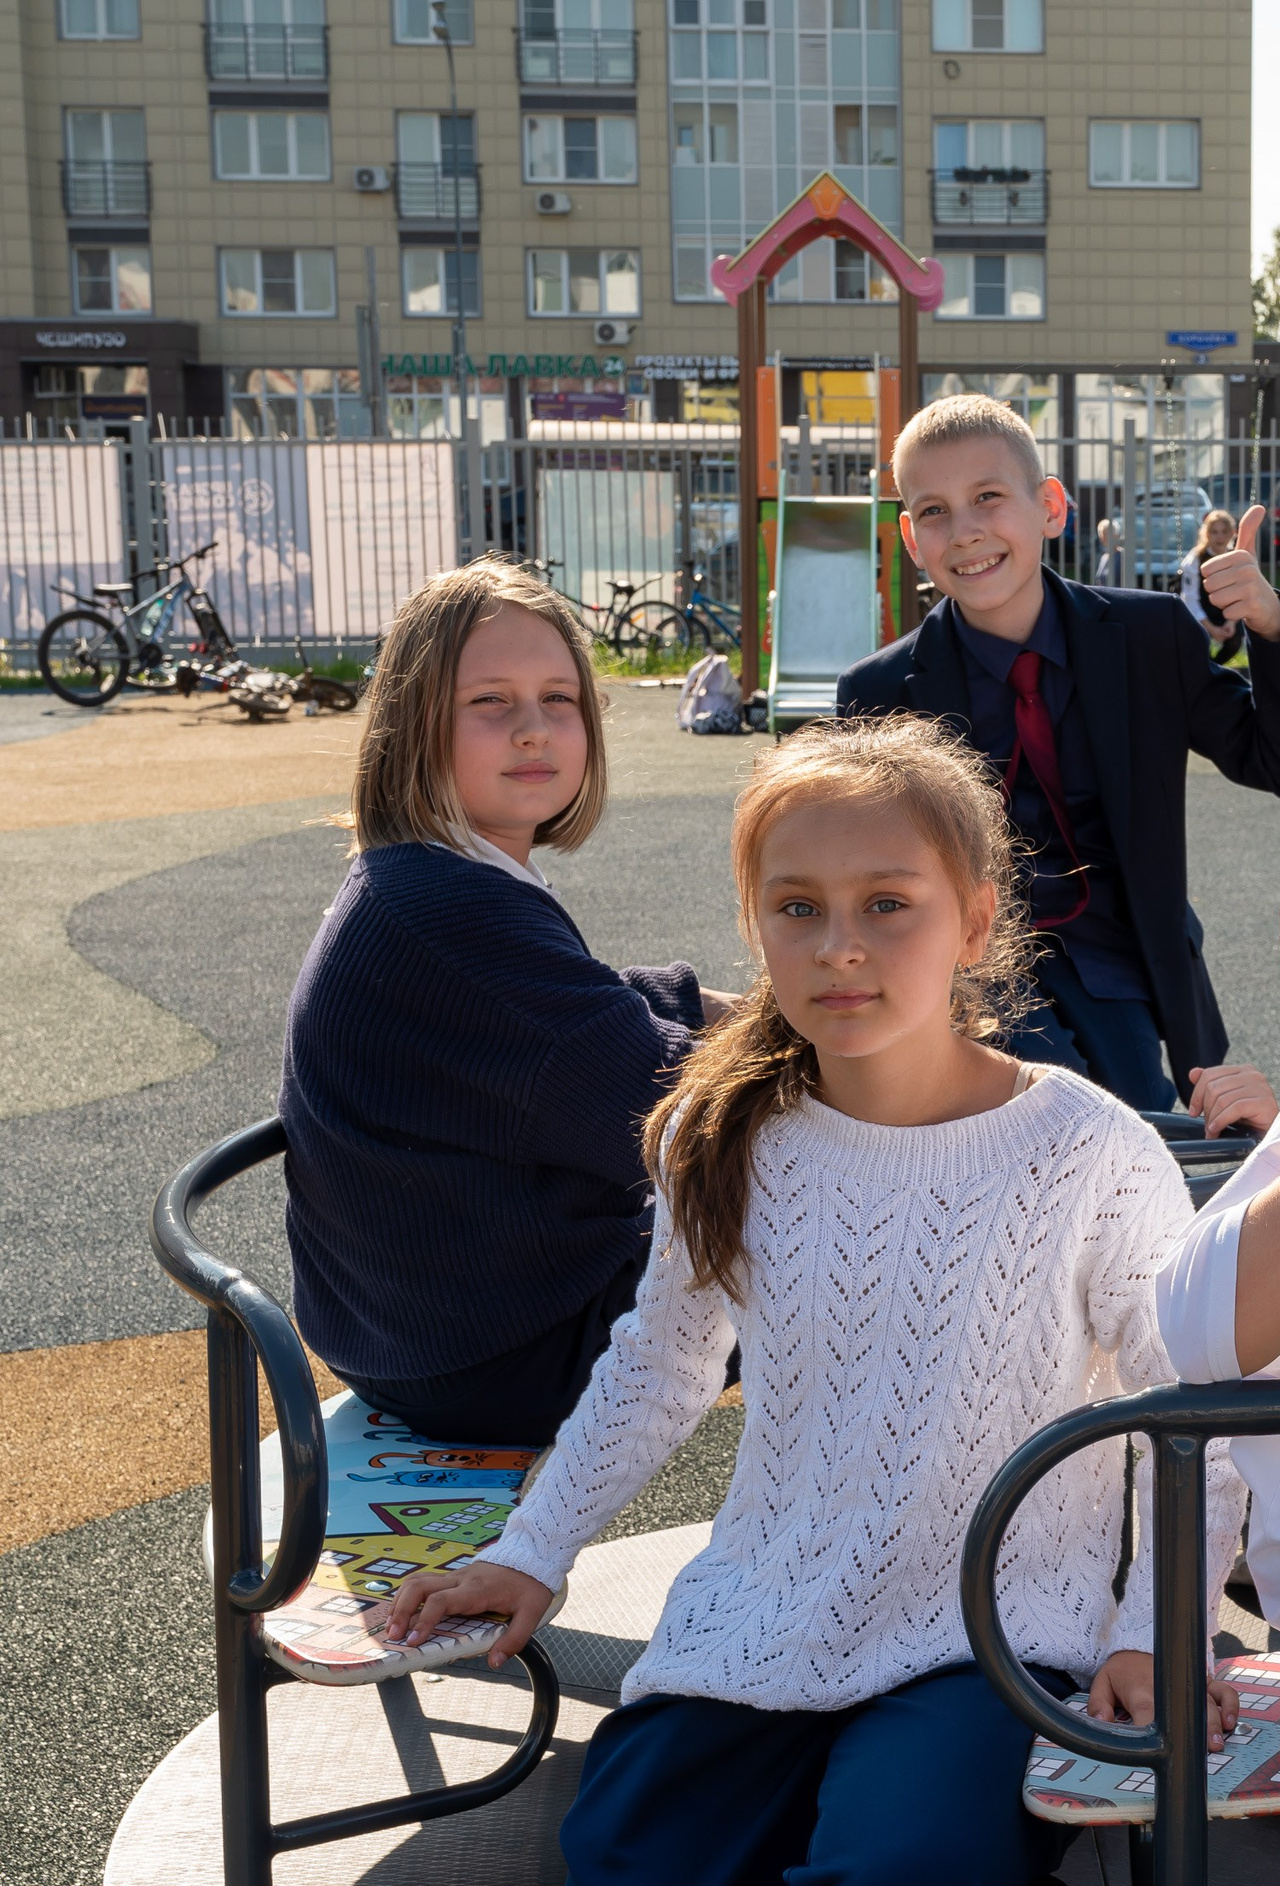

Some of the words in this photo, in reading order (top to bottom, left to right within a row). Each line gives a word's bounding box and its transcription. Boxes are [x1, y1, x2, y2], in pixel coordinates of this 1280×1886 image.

[485, 354, 601, 377] ЛАВКА
[603, 358, 624, 374] 24
[634, 355, 718, 367] ПРОДУКТЫ
[643, 367, 699, 379] ОВОЩИ
